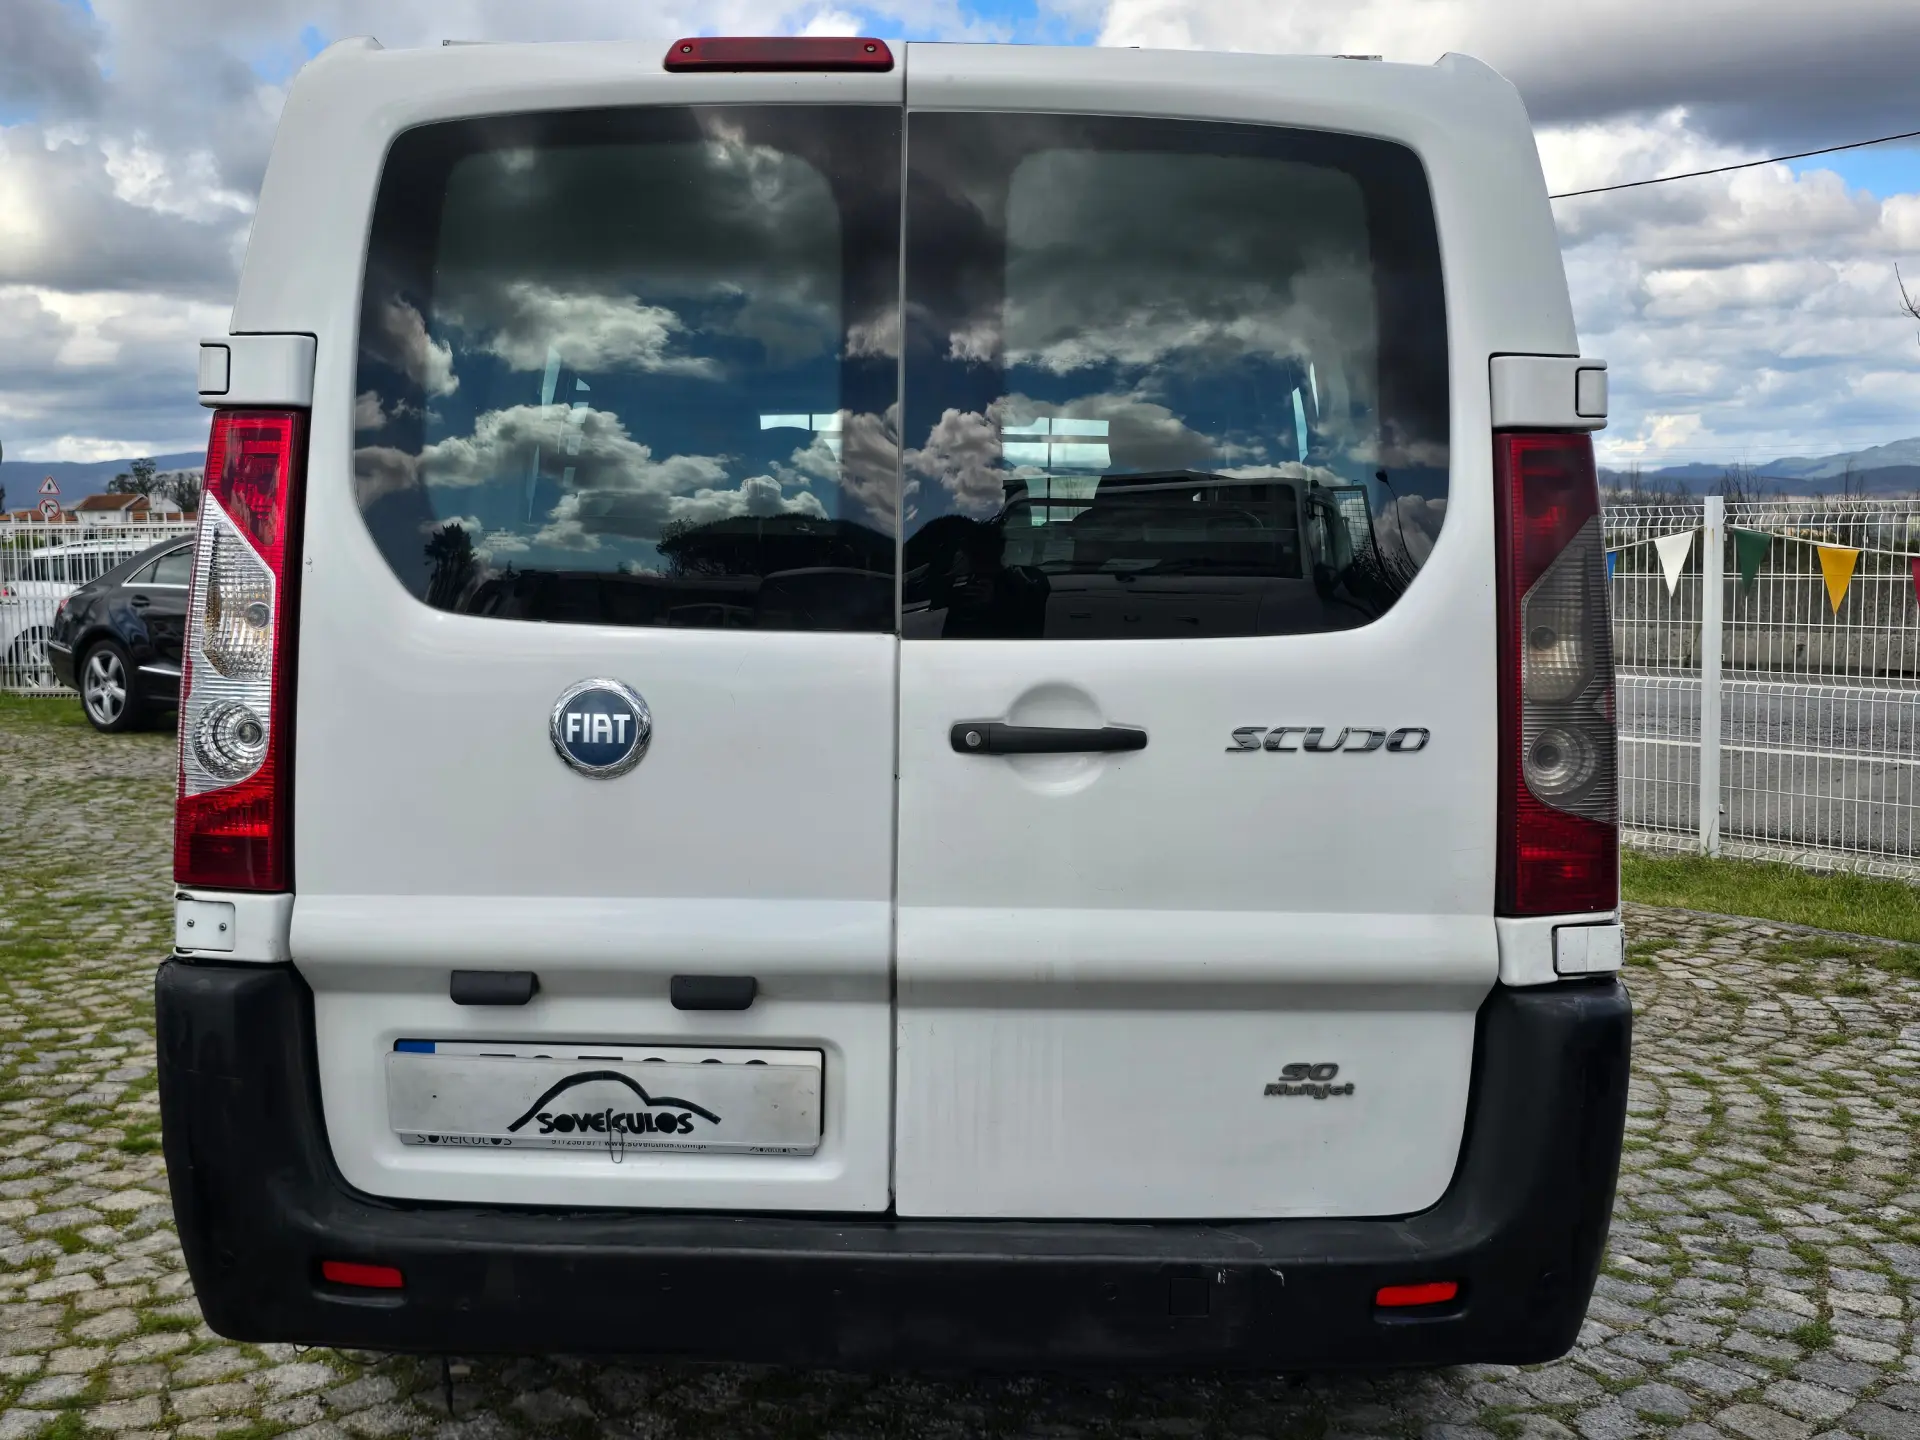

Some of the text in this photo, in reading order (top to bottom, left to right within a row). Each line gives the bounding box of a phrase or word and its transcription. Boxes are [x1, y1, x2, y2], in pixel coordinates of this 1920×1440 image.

[566, 712, 631, 744] FIAT
[1224, 726, 1431, 753] SCUDO
[1278, 1062, 1340, 1082] 90
